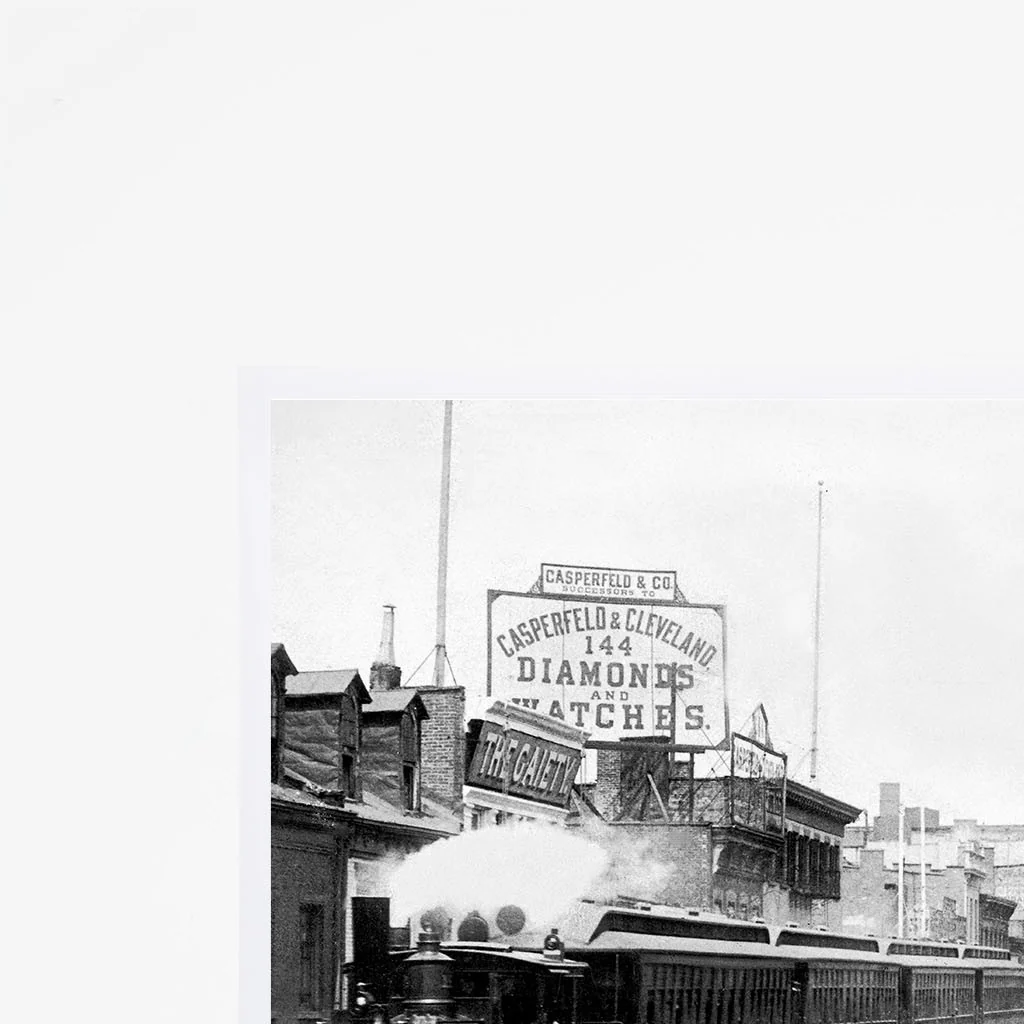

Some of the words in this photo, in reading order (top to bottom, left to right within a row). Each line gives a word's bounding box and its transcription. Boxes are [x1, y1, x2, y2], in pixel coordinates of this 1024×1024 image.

[546, 569, 631, 589] CASPERFELD
[637, 576, 646, 589] &
[562, 585, 634, 596] SUCCESSORS
[497, 606, 606, 658] CASPERFELD
[610, 611, 621, 630] &
[585, 635, 632, 656] 144
[517, 656, 694, 690] DIAMONDS
[591, 690, 629, 701] AND
[480, 732, 519, 779] THE
[513, 743, 577, 794] GAIETY
